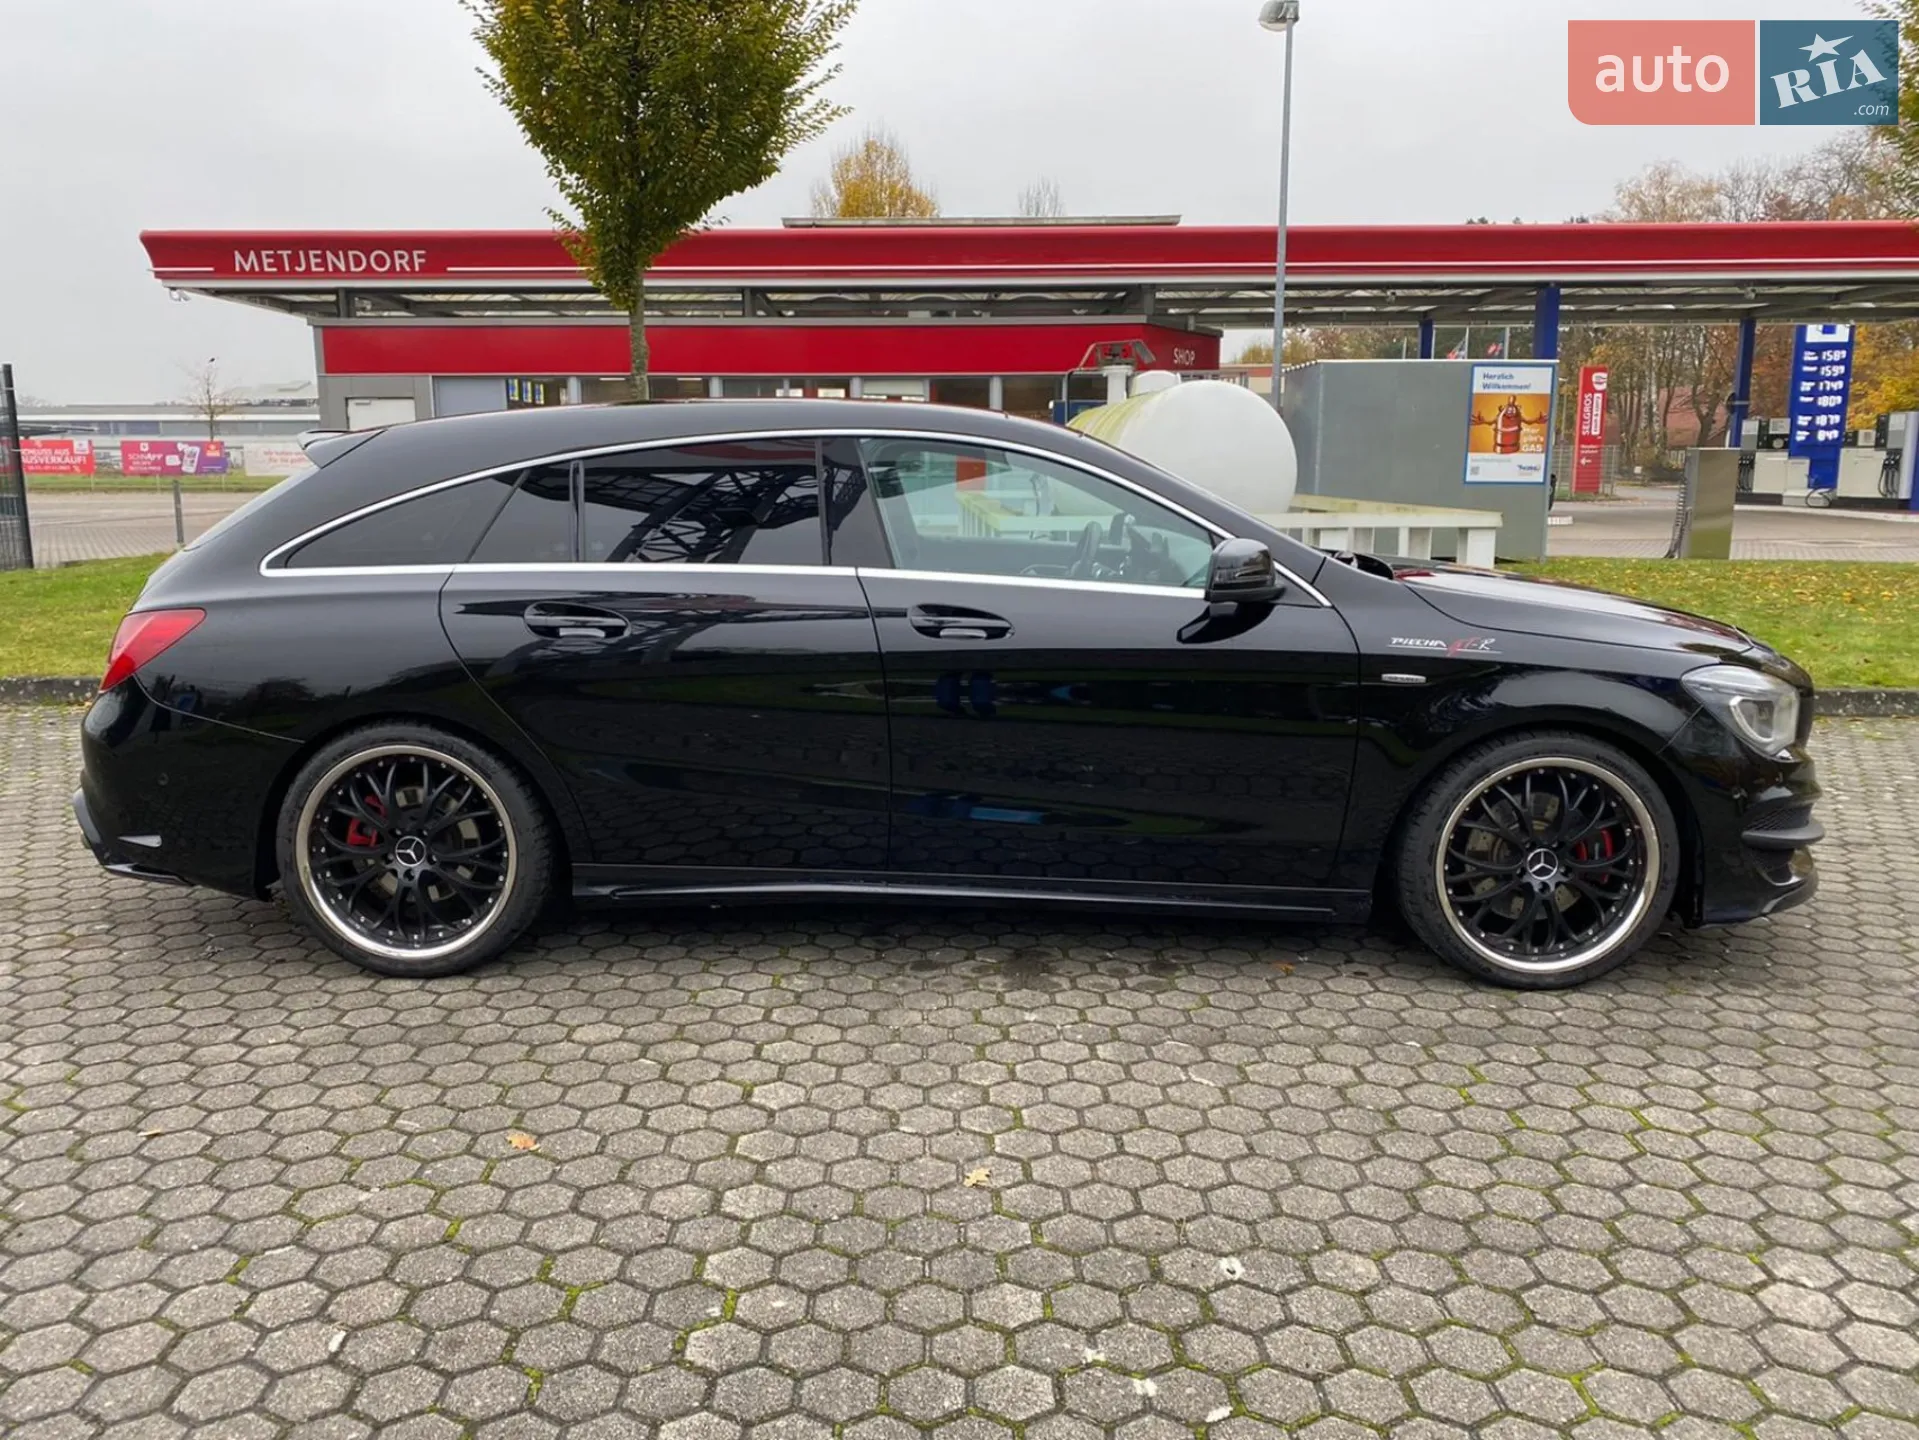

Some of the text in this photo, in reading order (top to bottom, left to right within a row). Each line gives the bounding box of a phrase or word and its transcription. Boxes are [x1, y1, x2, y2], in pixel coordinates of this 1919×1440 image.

[234, 250, 426, 272] METJENDORF
[1171, 347, 1196, 366] SHOP
[1482, 372, 1515, 380] Herzlich
[1582, 393, 1592, 436] SELGROS
[1522, 443, 1543, 452] GAS
